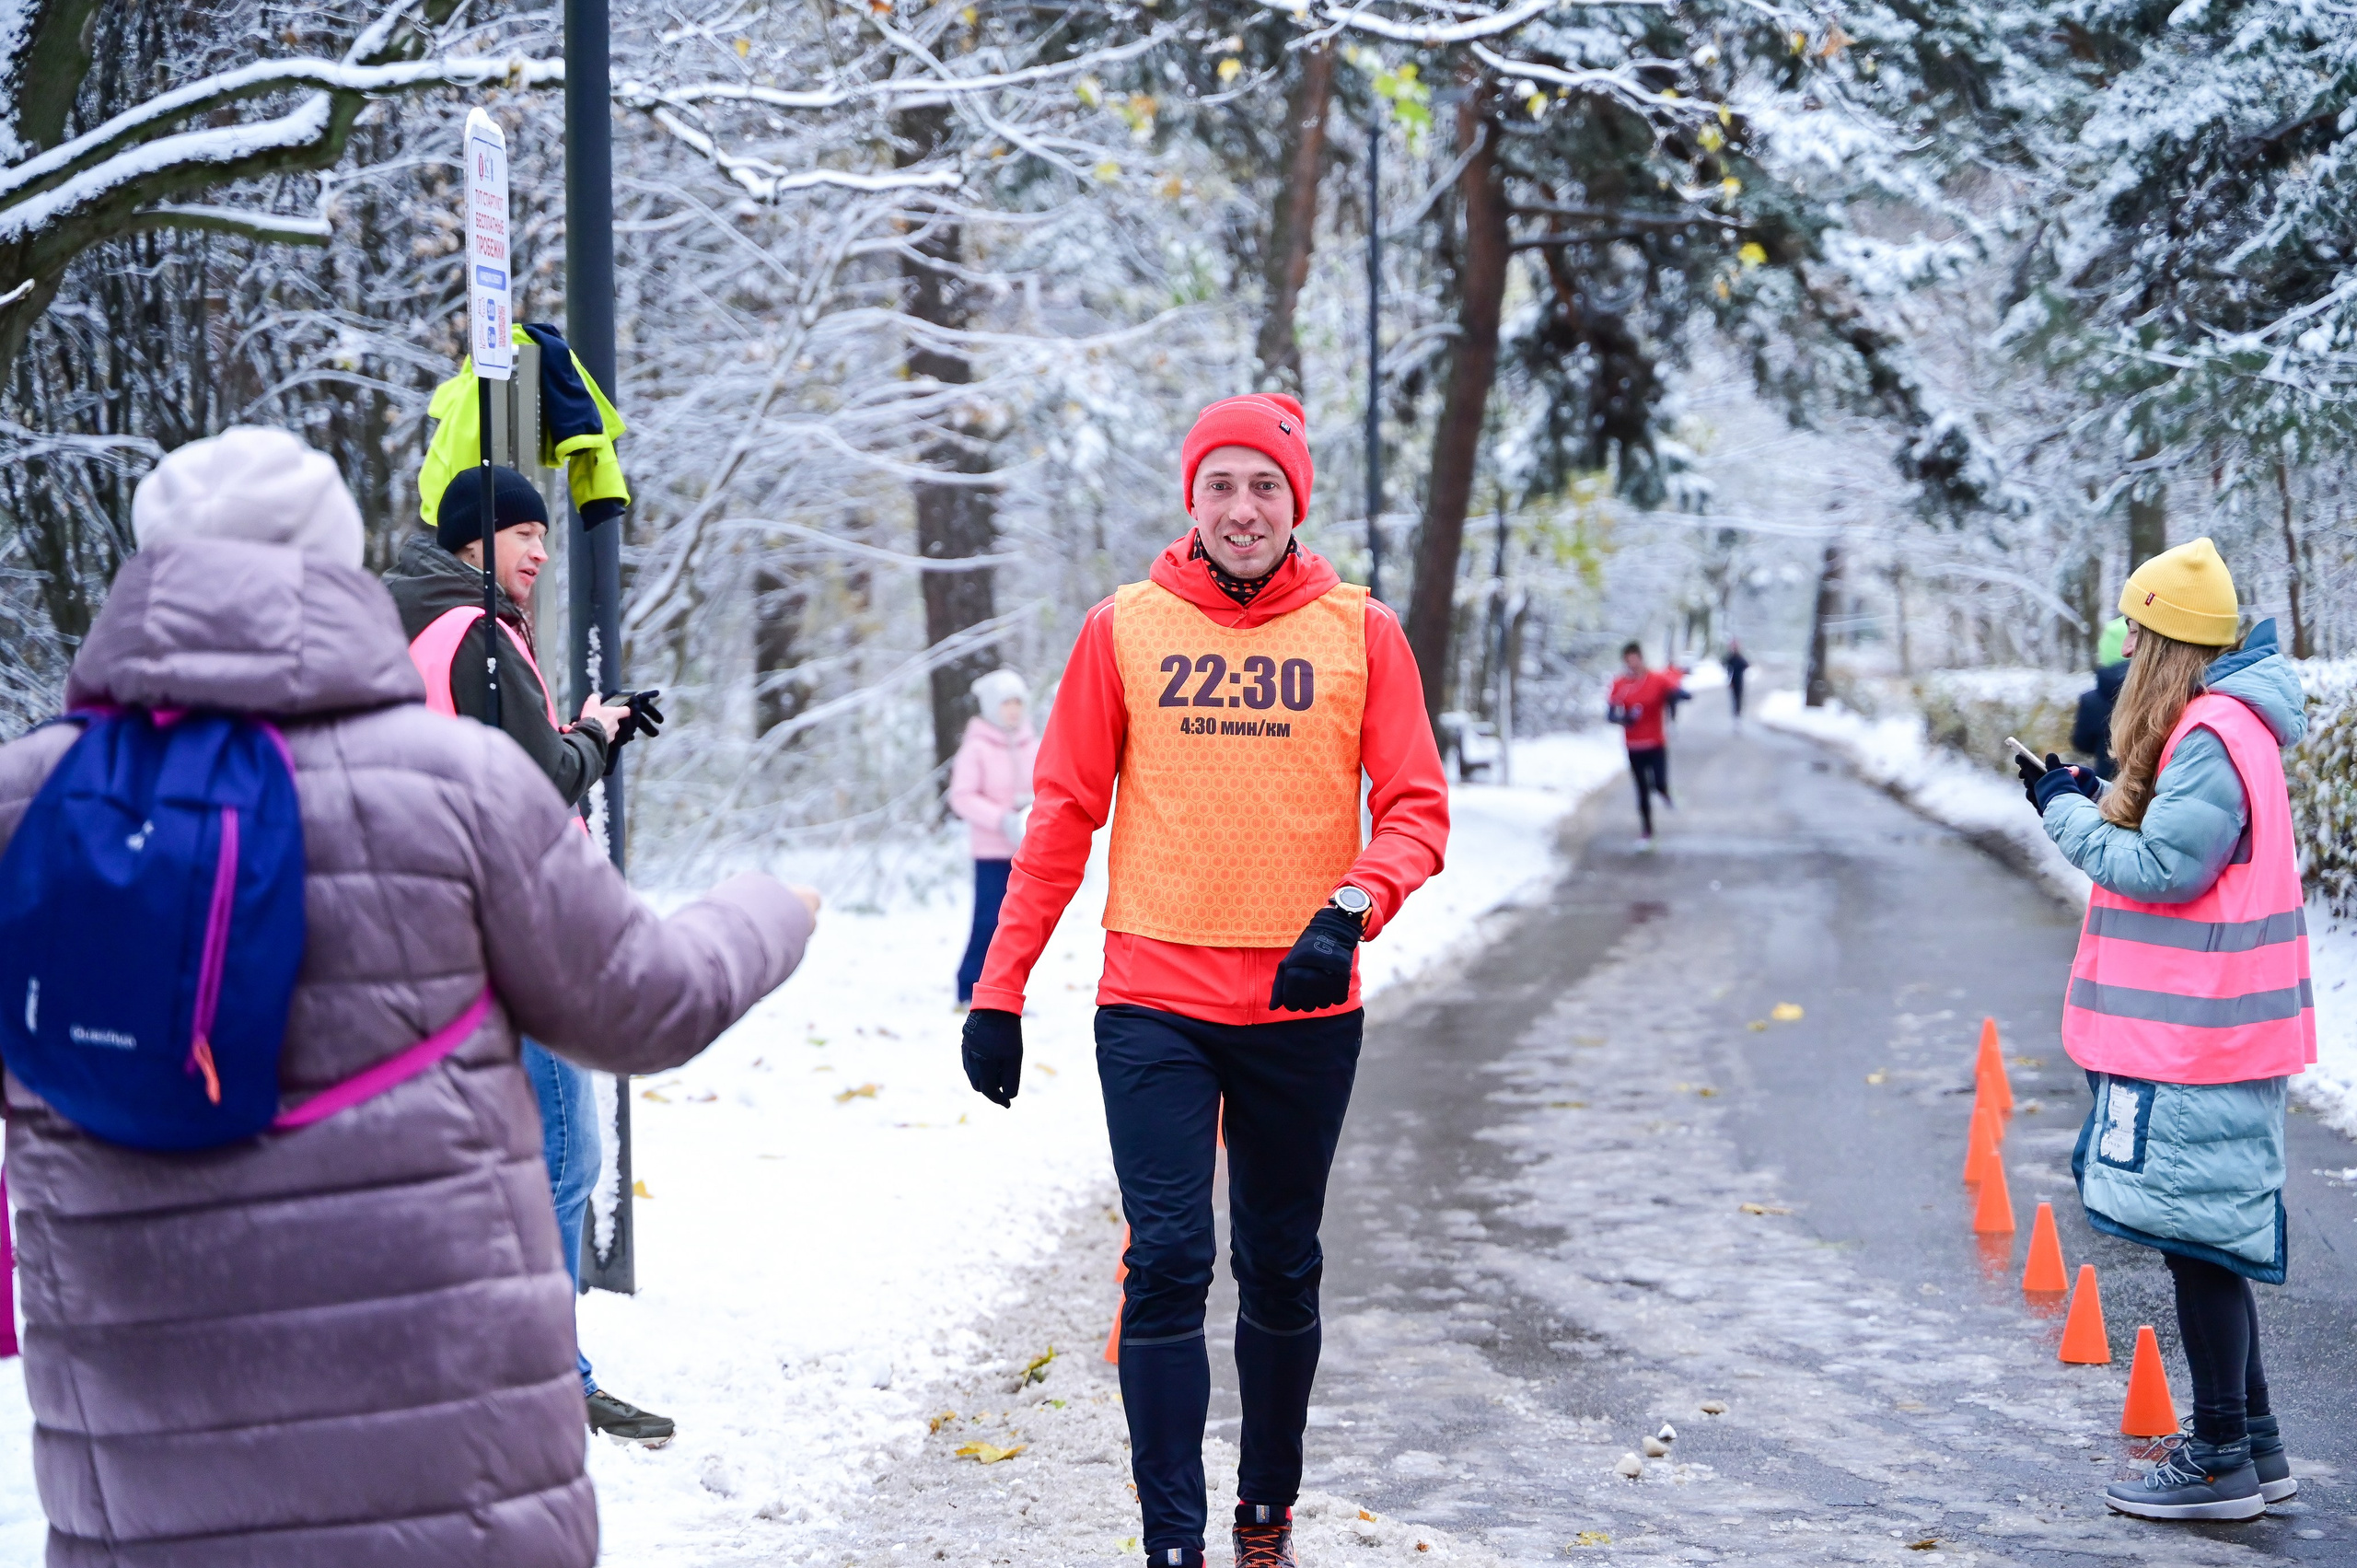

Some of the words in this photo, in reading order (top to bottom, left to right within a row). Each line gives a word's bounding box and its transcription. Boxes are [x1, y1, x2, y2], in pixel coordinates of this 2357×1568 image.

[476, 234, 505, 260] ПРОБЕЖКИ
[1158, 654, 1315, 711] 22:30
[1180, 717, 1217, 735] 4:30
